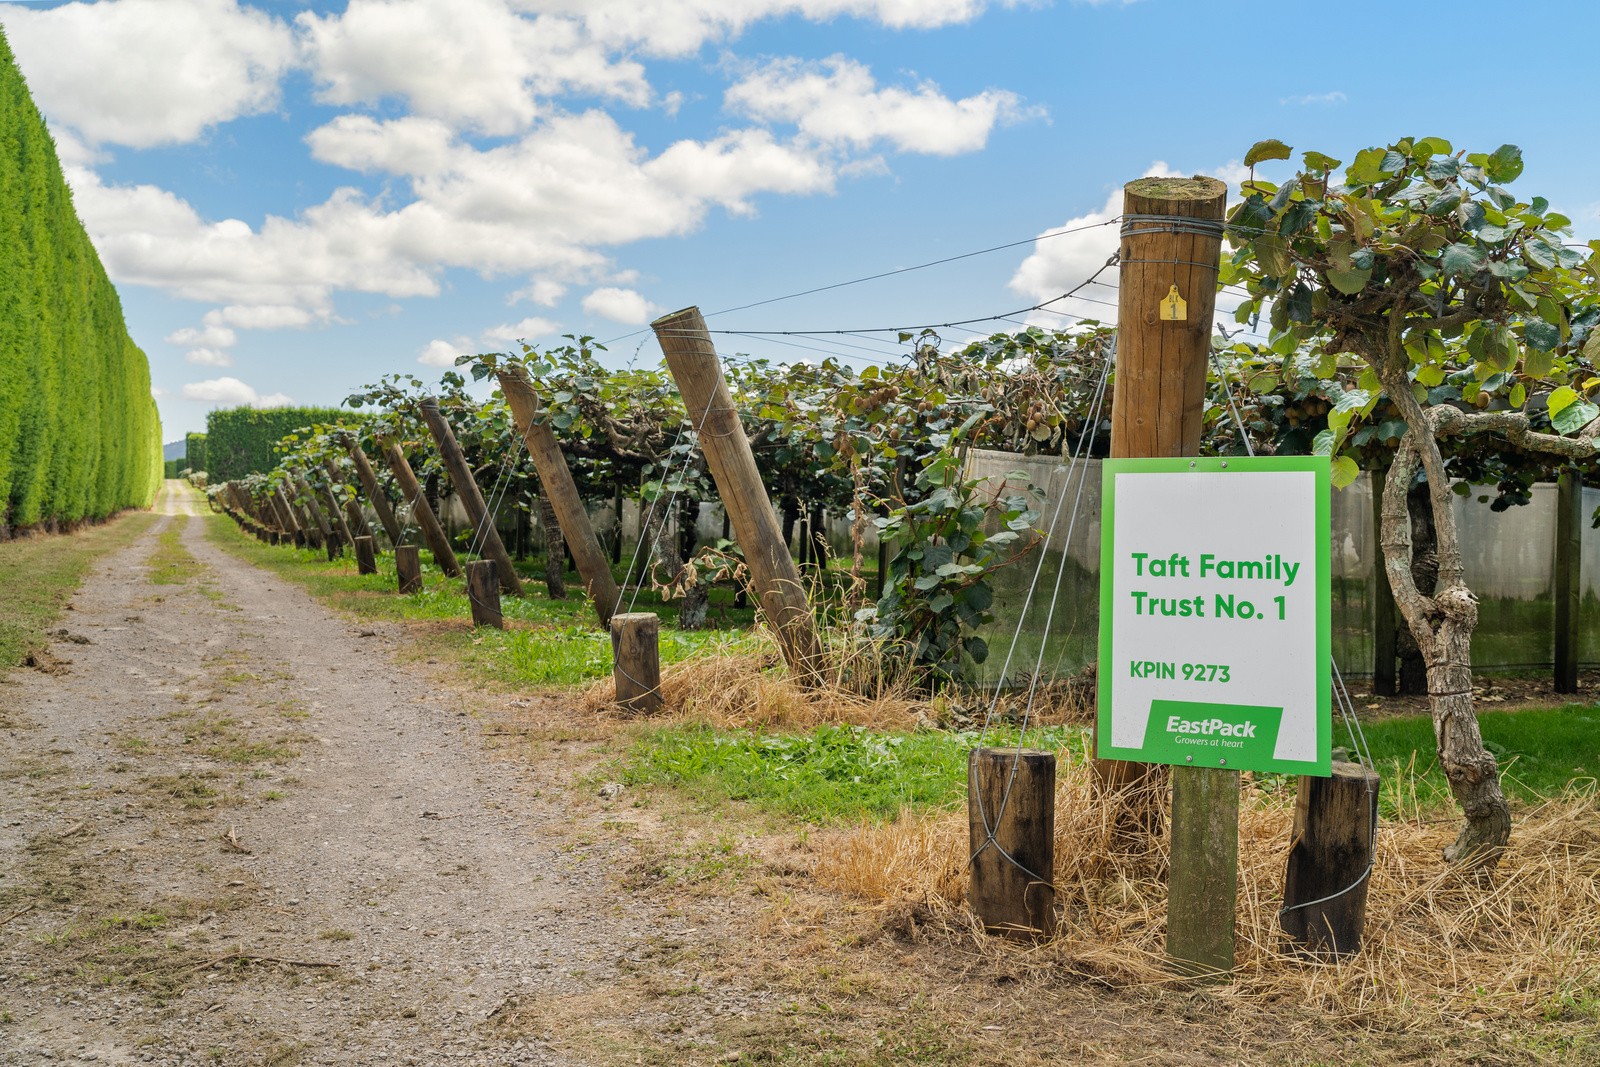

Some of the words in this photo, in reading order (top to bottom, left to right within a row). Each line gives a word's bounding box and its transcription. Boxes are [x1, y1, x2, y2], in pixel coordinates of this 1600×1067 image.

[1170, 304, 1179, 319] 1
[1131, 552, 1190, 577] Taft
[1199, 553, 1300, 587] Family
[1130, 591, 1205, 617] Trust
[1215, 593, 1264, 620] No.
[1273, 595, 1285, 621] 1
[1130, 660, 1175, 679] KPIN
[1181, 663, 1231, 683] 9273
[1166, 715, 1257, 738] EastPack
[1174, 735, 1209, 746] Growers
[1210, 738, 1219, 747] at
[1221, 738, 1244, 749] heart
